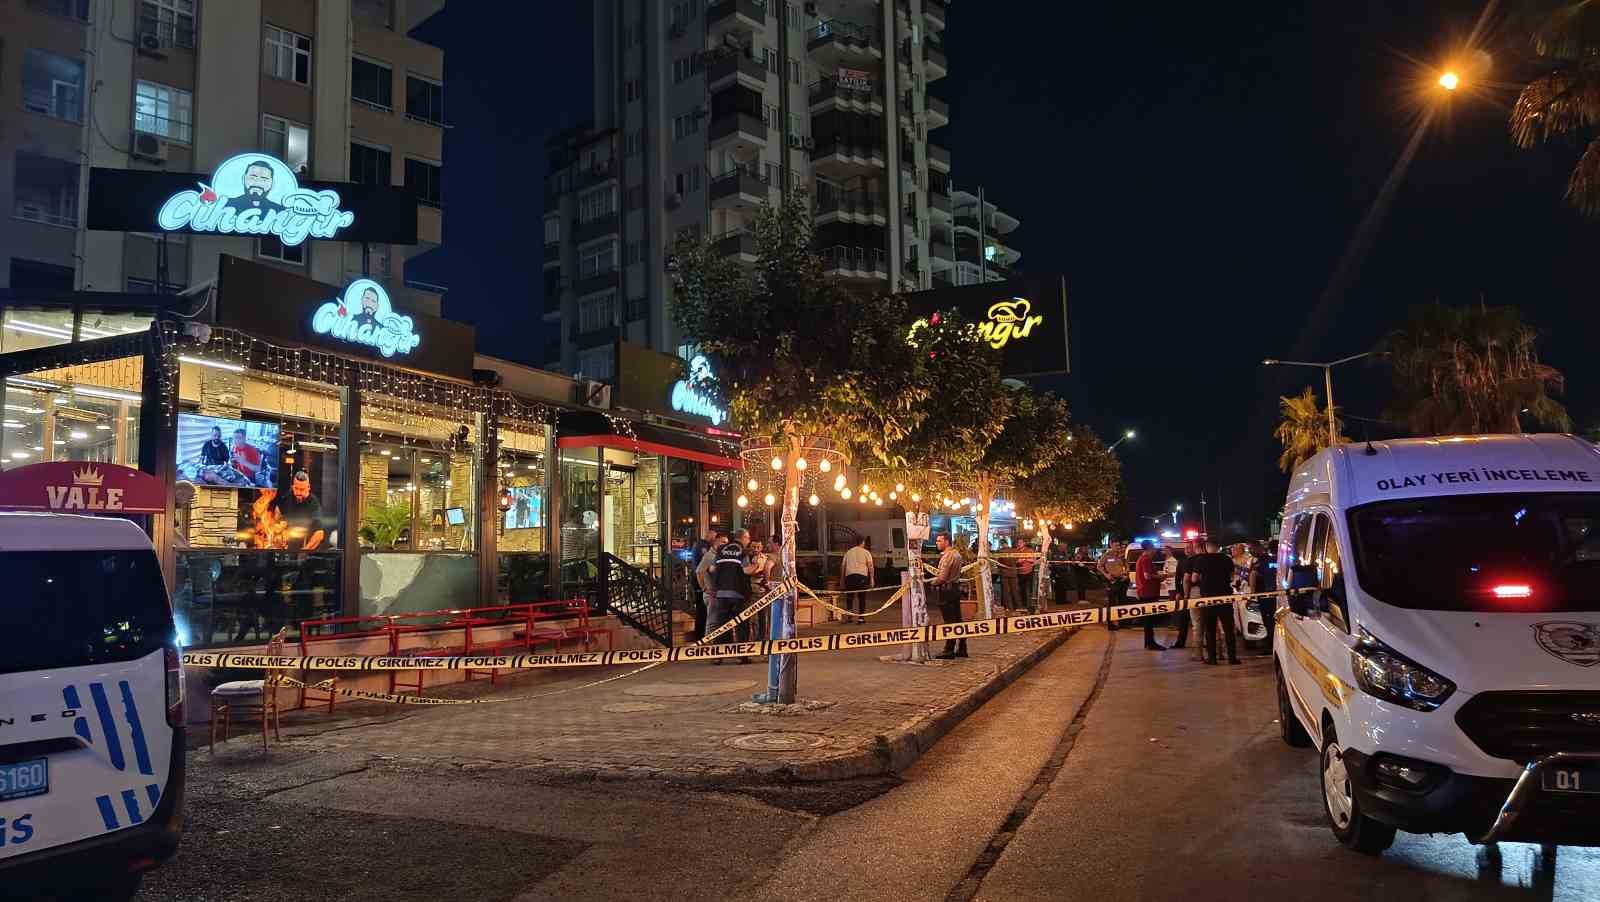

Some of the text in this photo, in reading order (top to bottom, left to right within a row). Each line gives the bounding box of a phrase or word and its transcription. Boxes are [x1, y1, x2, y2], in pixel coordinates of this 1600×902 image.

[1376, 474, 1426, 491] OLAY
[46, 486, 123, 510] VALE
[1556, 770, 1580, 789] 01
